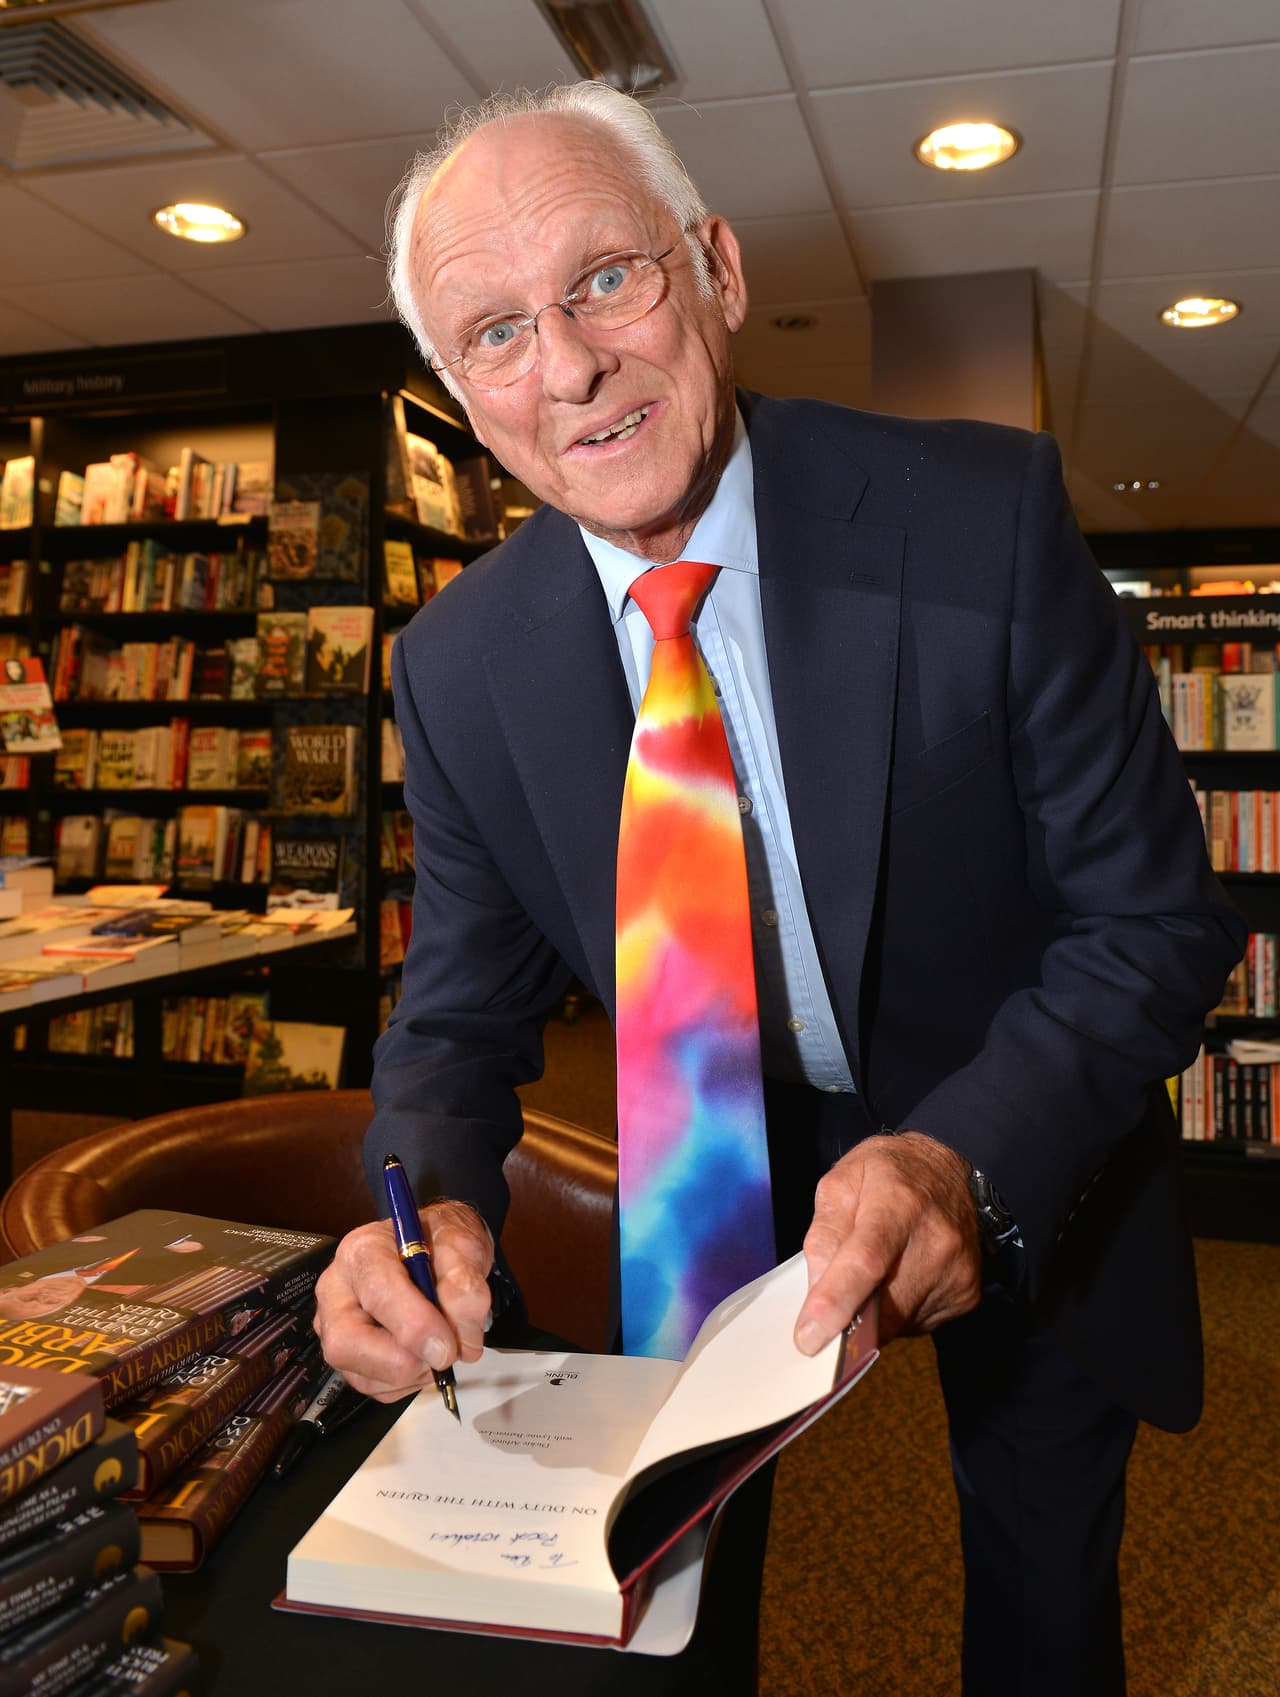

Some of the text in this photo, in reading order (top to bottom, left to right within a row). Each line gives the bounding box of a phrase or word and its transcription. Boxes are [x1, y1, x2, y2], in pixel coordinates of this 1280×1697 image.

[23, 373, 125, 397] Military history
[1146, 611, 1205, 630] Smart
[290, 734, 345, 750] WORLD
[296, 750, 330, 764] WAR
[65, 1305, 164, 1329] WITH THE
[111, 1303, 181, 1320] QUEEN
[0, 1319, 137, 1357] ARBI
[56, 1315, 149, 1337] ON DUTY
[149, 1314, 227, 1374] ARBITER
[0, 1412, 92, 1497] DICKIE
[376, 1489, 598, 1516] ON DUTY WITH THE QUEEN
